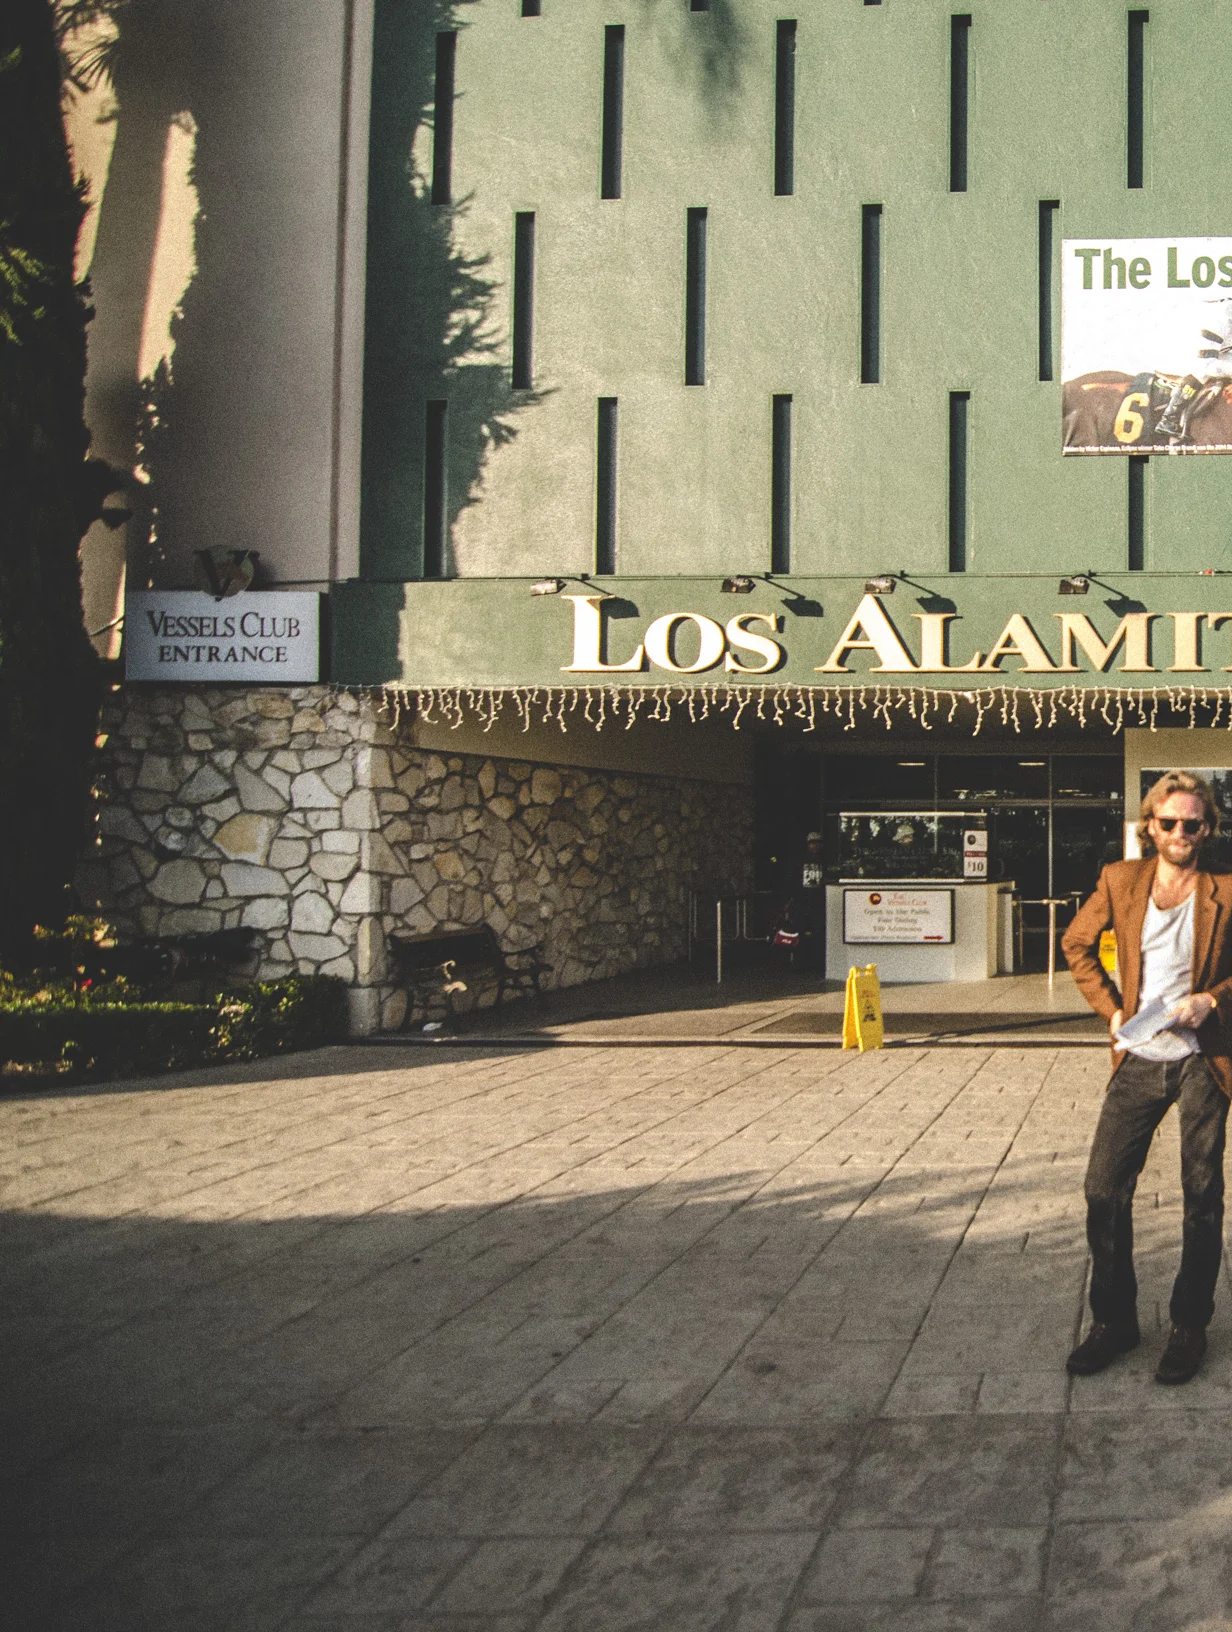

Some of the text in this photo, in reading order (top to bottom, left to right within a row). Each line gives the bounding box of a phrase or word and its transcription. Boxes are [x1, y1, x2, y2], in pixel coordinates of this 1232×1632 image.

[1074, 247, 1152, 290] The
[1113, 392, 1150, 444] 6
[146, 610, 301, 638] VESSELS CLUB
[560, 594, 786, 674] LOS
[157, 645, 289, 663] ENTRANCE
